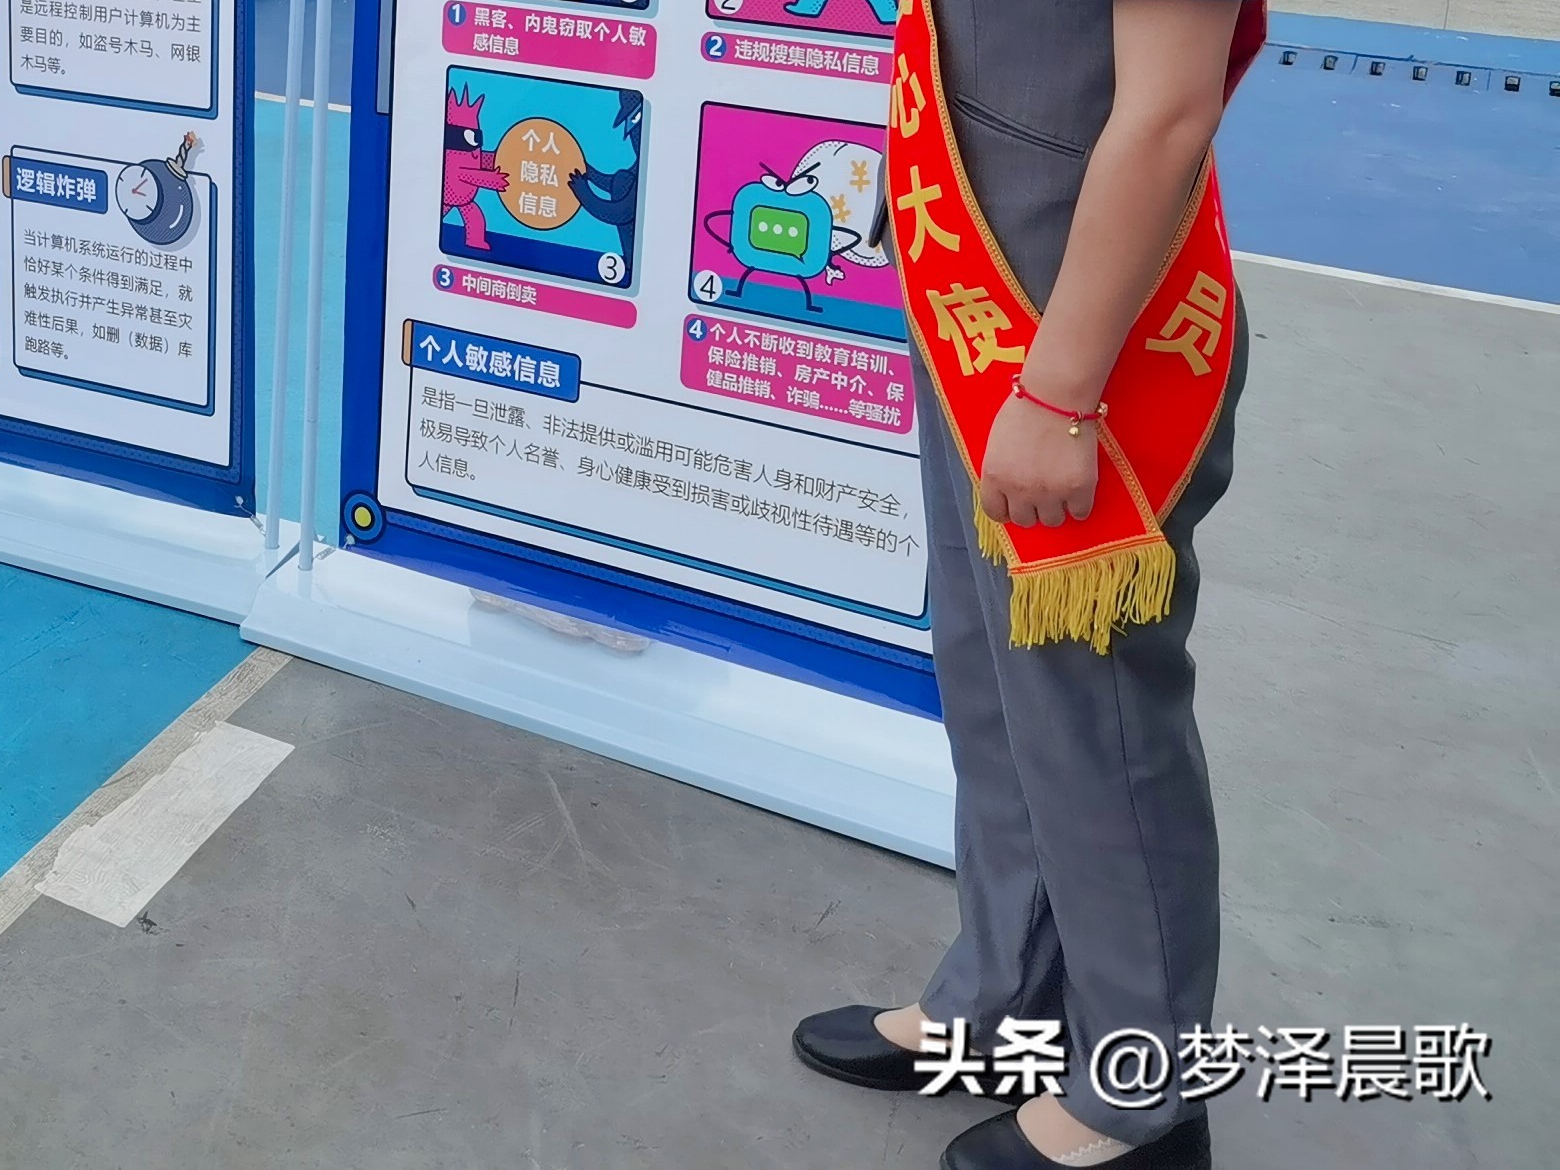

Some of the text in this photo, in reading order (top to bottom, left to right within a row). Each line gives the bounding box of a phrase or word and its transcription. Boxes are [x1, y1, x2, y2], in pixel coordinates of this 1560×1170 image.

[473, 33, 520, 57] 感信息
[474, 8, 647, 48] 黑客、内鬼窃取个人敏
[20, 54, 67, 78] 木马等。
[734, 40, 880, 76] 违规搜集隐私信息
[521, 129, 561, 156] 个人
[16, 167, 98, 204] 逻辑炸弹
[520, 160, 560, 188] 隐私
[518, 192, 558, 219] 信息
[23, 229, 194, 273] 当计算机系统运行的过程中
[23, 282, 194, 330] 触发执行并产生异常甚至灾
[461, 272, 538, 306] 中间商倒卖
[1145, 270, 1227, 377] 员
[24, 336, 70, 361] 跑路等。
[419, 335, 561, 389] 个人敏感信息
[709, 322, 896, 377] 个人不断收到教育培训、
[707, 345, 905, 403] 保险推销、房产中介、保
[418, 450, 477, 481] 人信息。
